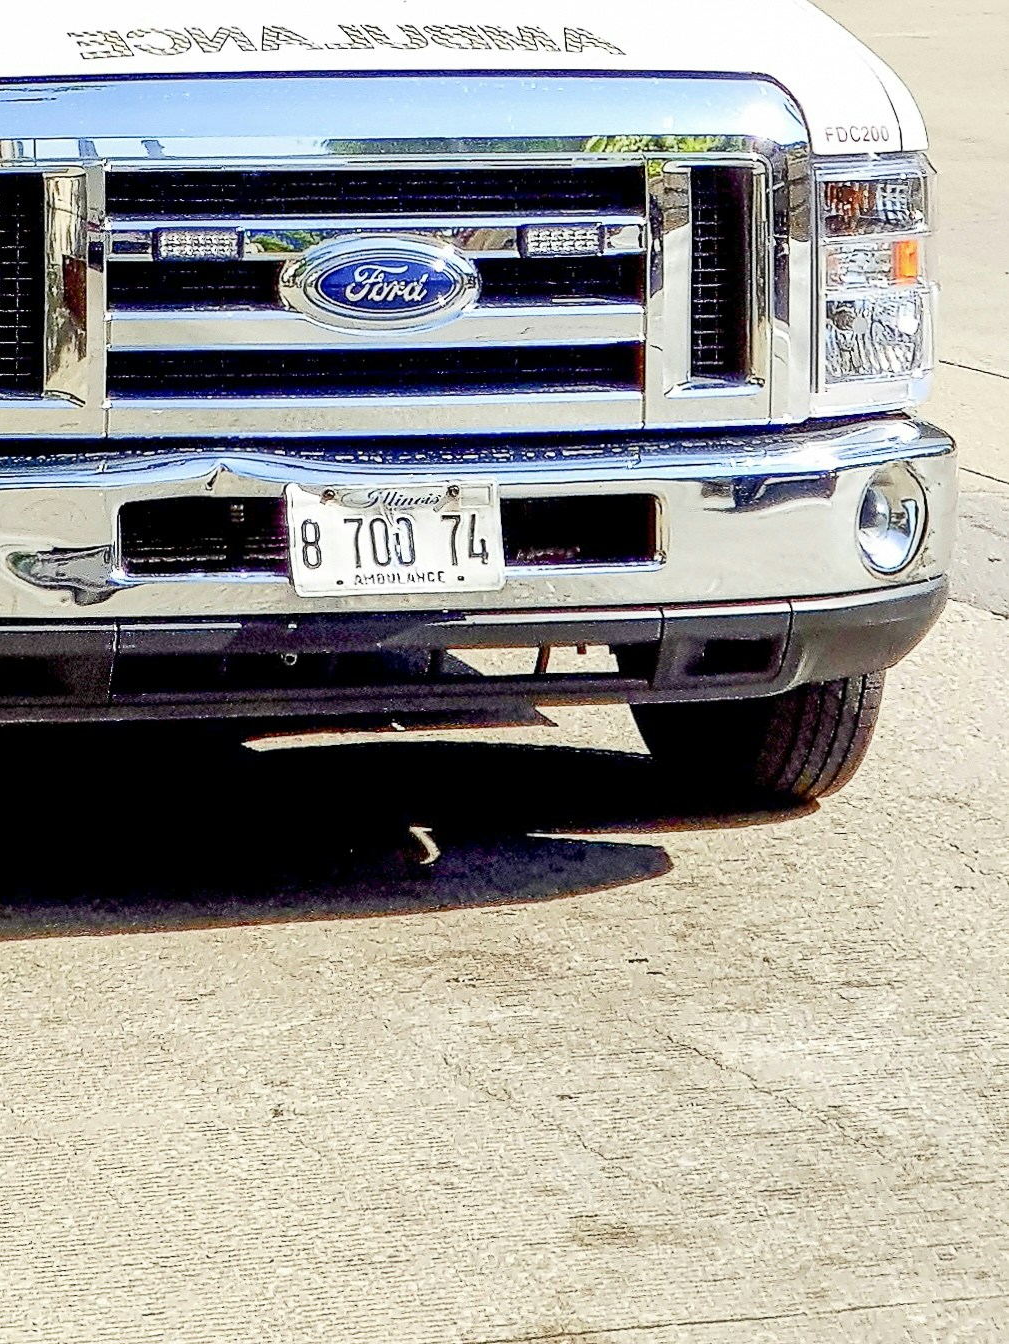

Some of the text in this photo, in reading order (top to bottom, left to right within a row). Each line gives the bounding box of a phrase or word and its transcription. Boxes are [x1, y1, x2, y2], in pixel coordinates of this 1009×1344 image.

[825, 125, 891, 144] FDC200
[345, 264, 429, 304] Ford
[365, 489, 441, 508] Illinois
[301, 518, 322, 569] 8
[441, 513, 489, 566] 74
[354, 571, 445, 585] AMBULANCE
